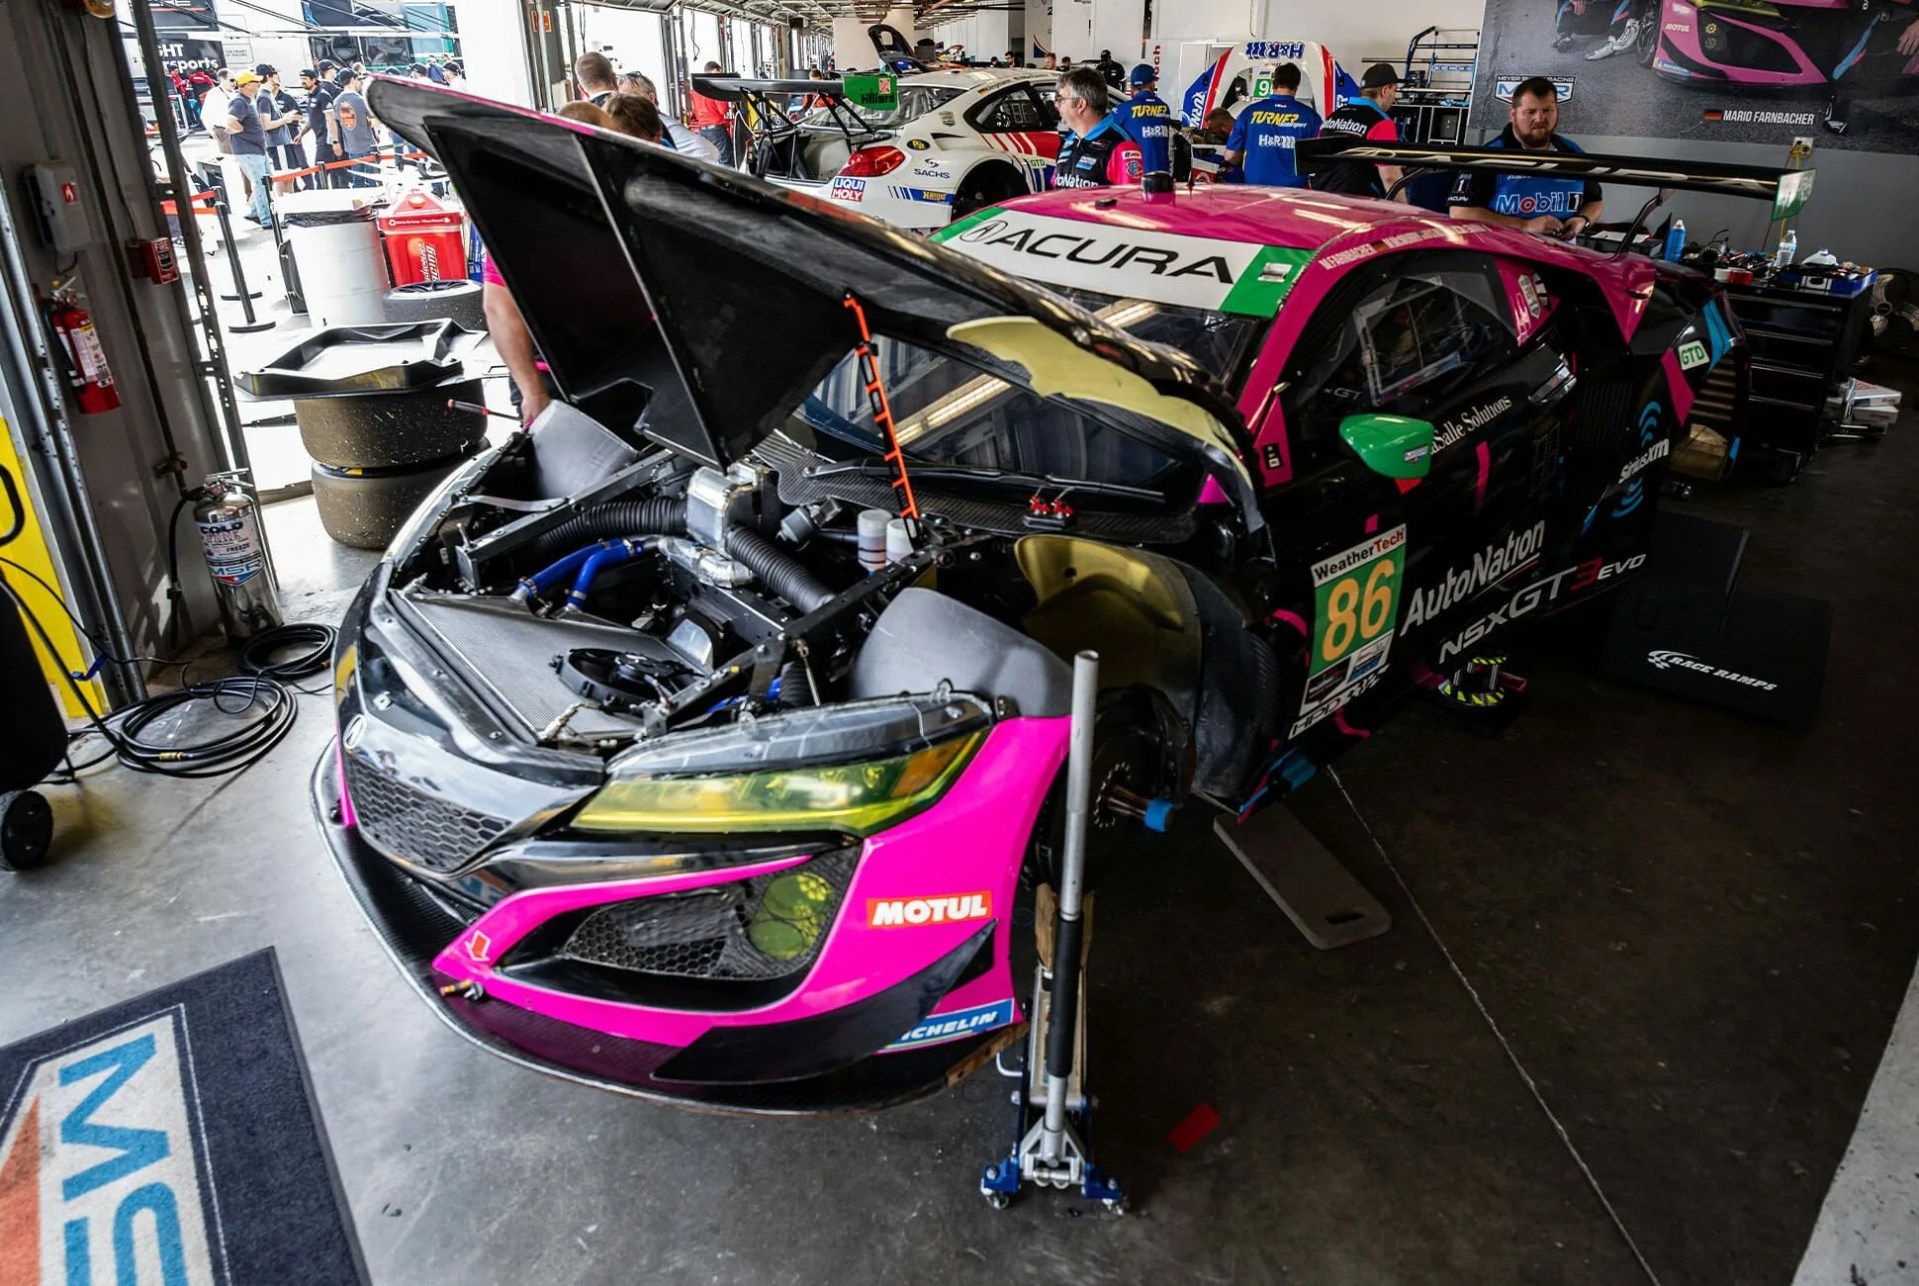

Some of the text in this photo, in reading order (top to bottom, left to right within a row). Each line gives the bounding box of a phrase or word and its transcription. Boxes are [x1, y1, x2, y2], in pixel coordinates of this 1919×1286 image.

[1132, 105, 1168, 119] TURNER
[1251, 111, 1300, 125] TURNER
[1723, 110, 1815, 125] MARIO FARNBACHER
[914, 168, 951, 179] SACHS
[835, 178, 864, 190] LIQUI
[832, 189, 862, 200] MOLY
[1495, 192, 1565, 214] Mobil
[986, 228, 1234, 285] ACURA
[1681, 345, 1706, 366] GTD
[1461, 396, 1513, 432] Solutions
[200, 521, 244, 534] COLD
[226, 543, 250, 552] FREEZE
[1314, 528, 1405, 581] WeatherTech
[209, 559, 262, 576] MSR
[1400, 520, 1545, 638] AutoNation
[1321, 559, 1395, 662] 86
[1668, 656, 1778, 691] RACE RAMPS
[872, 895, 988, 926] MOTUL
